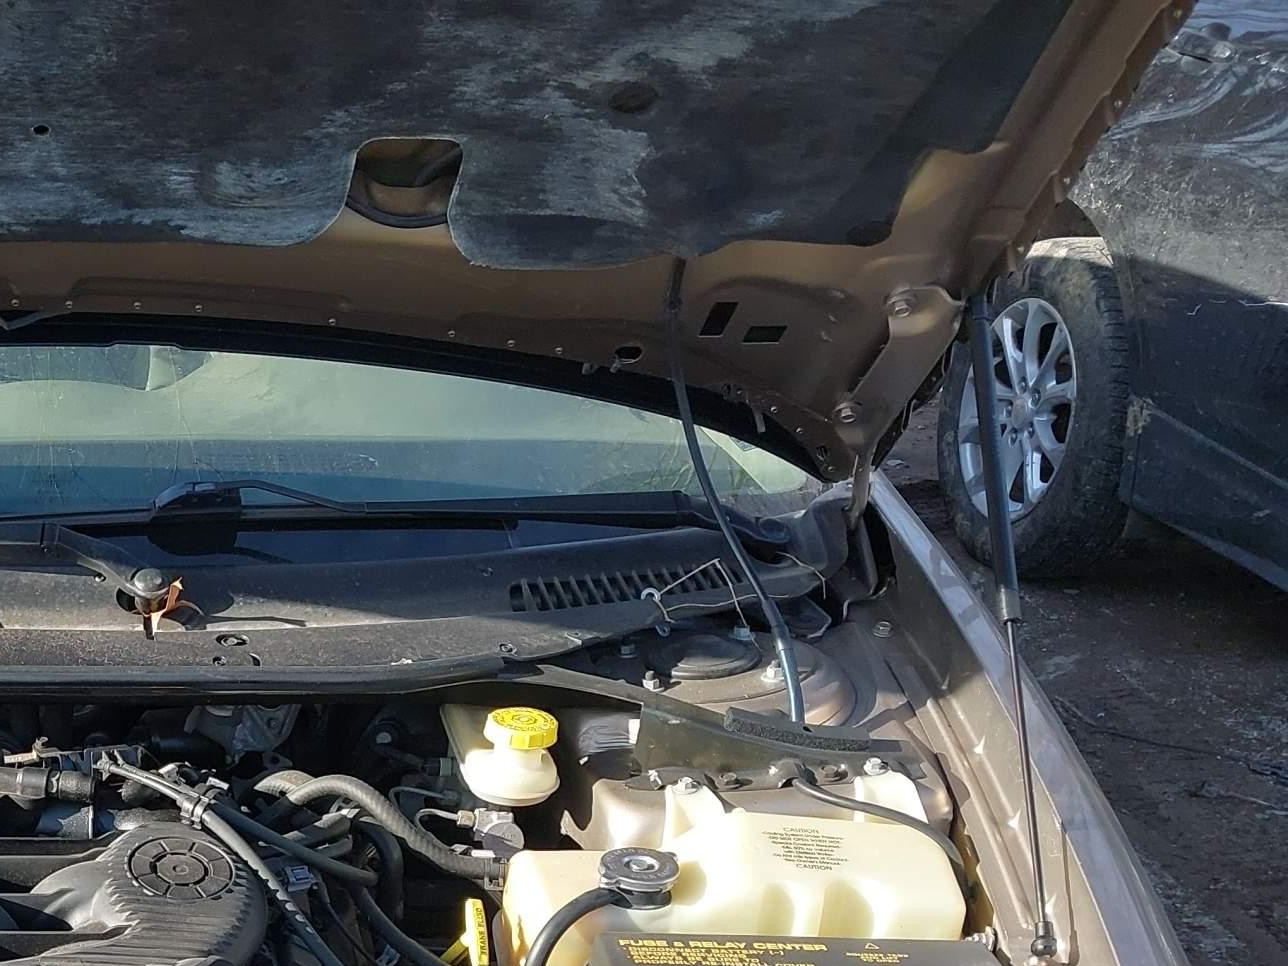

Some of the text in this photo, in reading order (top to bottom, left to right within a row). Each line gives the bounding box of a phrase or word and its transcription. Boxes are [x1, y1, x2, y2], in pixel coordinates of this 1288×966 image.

[619, 939, 668, 947] FUSE
[688, 940, 746, 949] RELAY
[752, 942, 828, 951] CENTER
